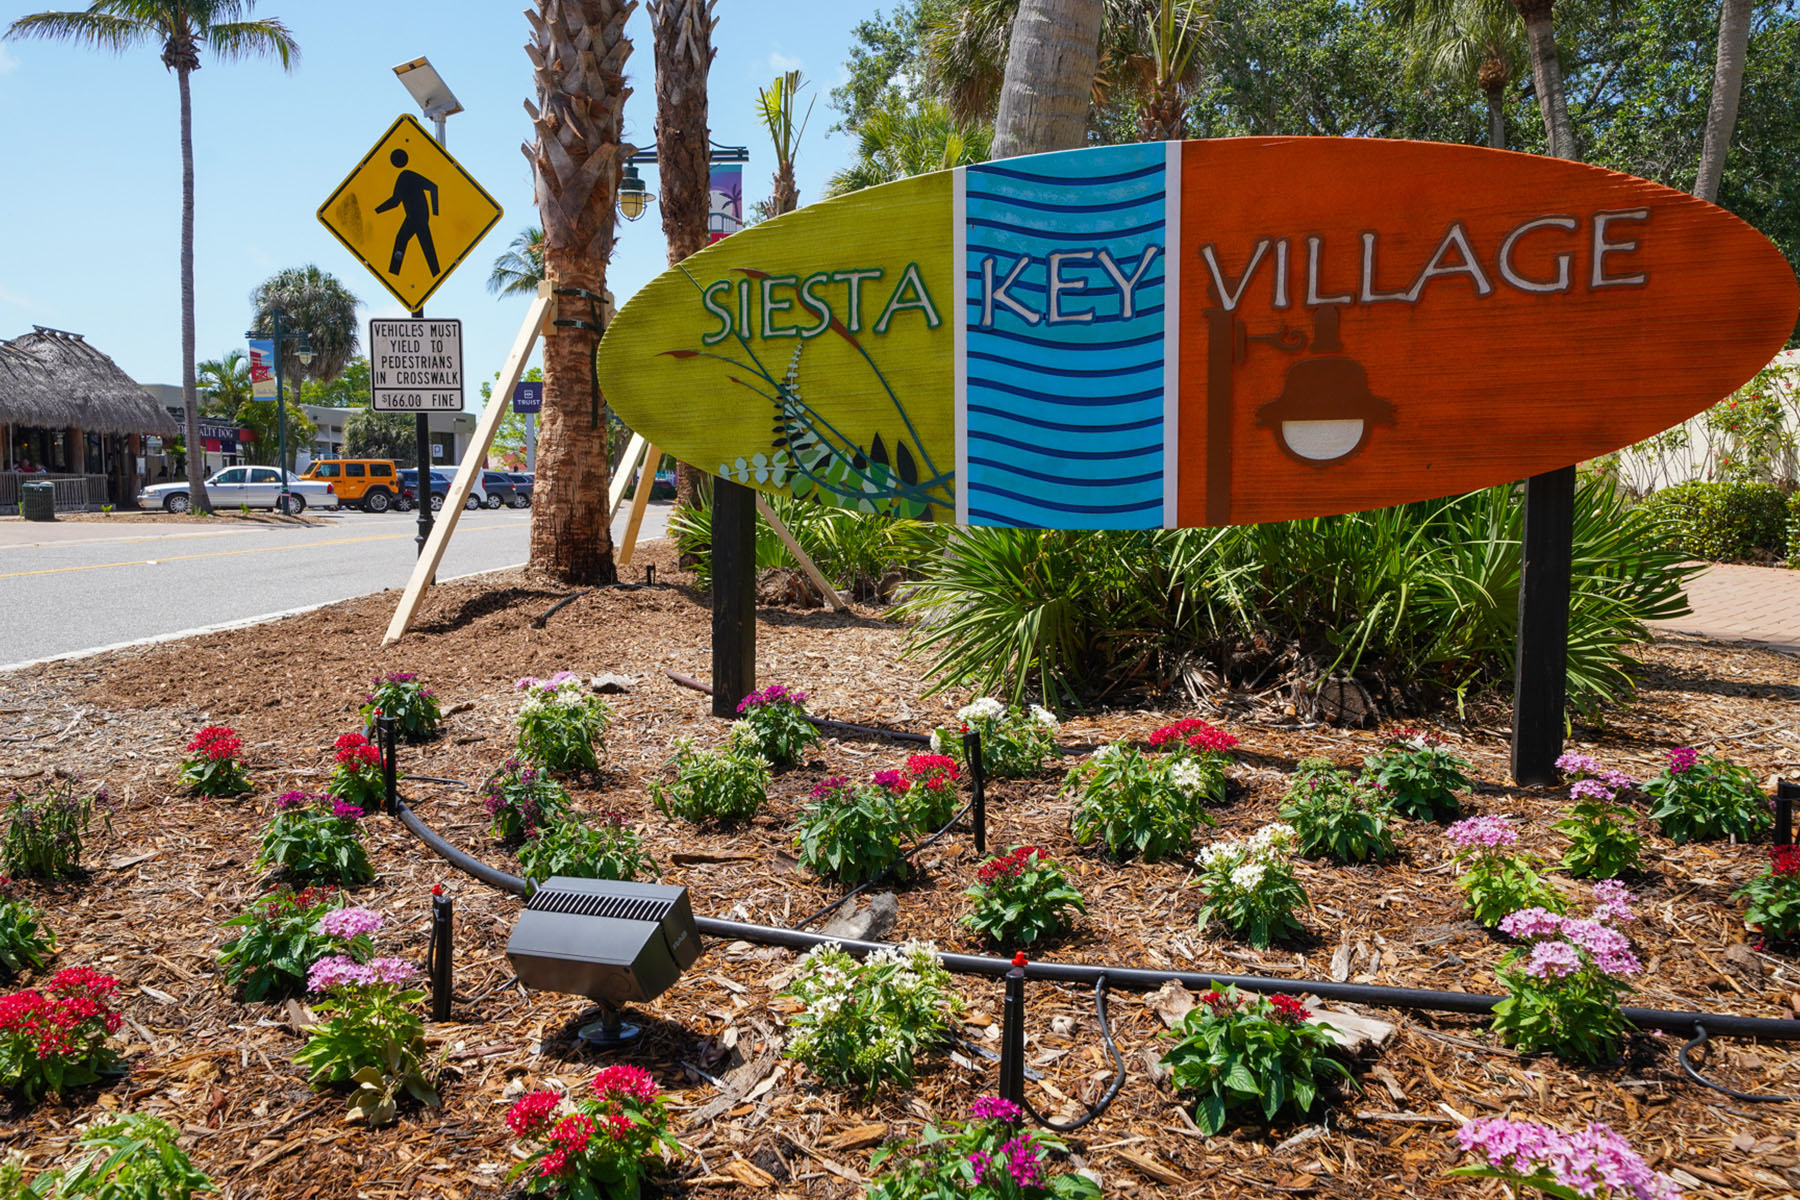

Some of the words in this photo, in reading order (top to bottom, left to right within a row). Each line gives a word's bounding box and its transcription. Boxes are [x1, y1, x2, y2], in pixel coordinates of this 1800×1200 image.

[702, 262, 942, 344] SIESTA
[978, 244, 1163, 331] KEY
[1201, 207, 1651, 312] VILLAGE
[374, 324, 424, 337] VEHICLES
[430, 324, 457, 337] MUST
[390, 340, 420, 353] YIELD
[431, 340, 443, 353] TO
[381, 356, 452, 369] PEDESTRIANS
[376, 372, 386, 384] IN
[396, 371, 458, 384] CROSSWALK
[382, 394, 421, 407] $166.00
[432, 394, 455, 407] FINE
